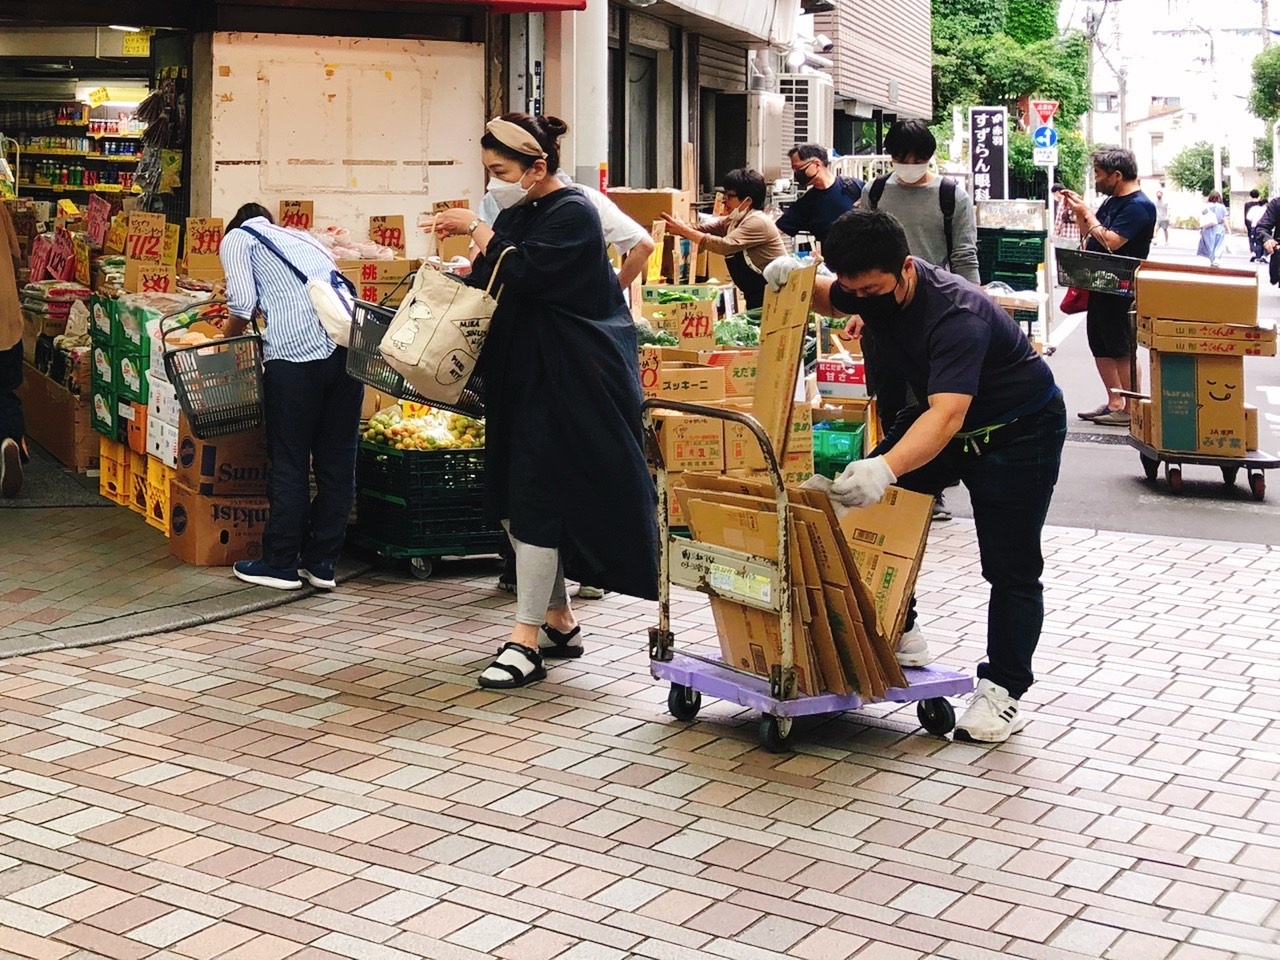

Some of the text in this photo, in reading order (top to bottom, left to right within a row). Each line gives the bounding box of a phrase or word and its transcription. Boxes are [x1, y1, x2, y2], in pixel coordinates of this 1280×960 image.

[974, 113, 991, 200] すずらん眼科
[361, 263, 378, 281] 桃
[361, 286, 378, 303] 桃
[732, 366, 758, 379] えだま
[825, 371, 866, 385] 甘さ一
[662, 379, 709, 392] ズッキーニ
[783, 471, 812, 484] だまめ
[210, 503, 269, 529] nkist
